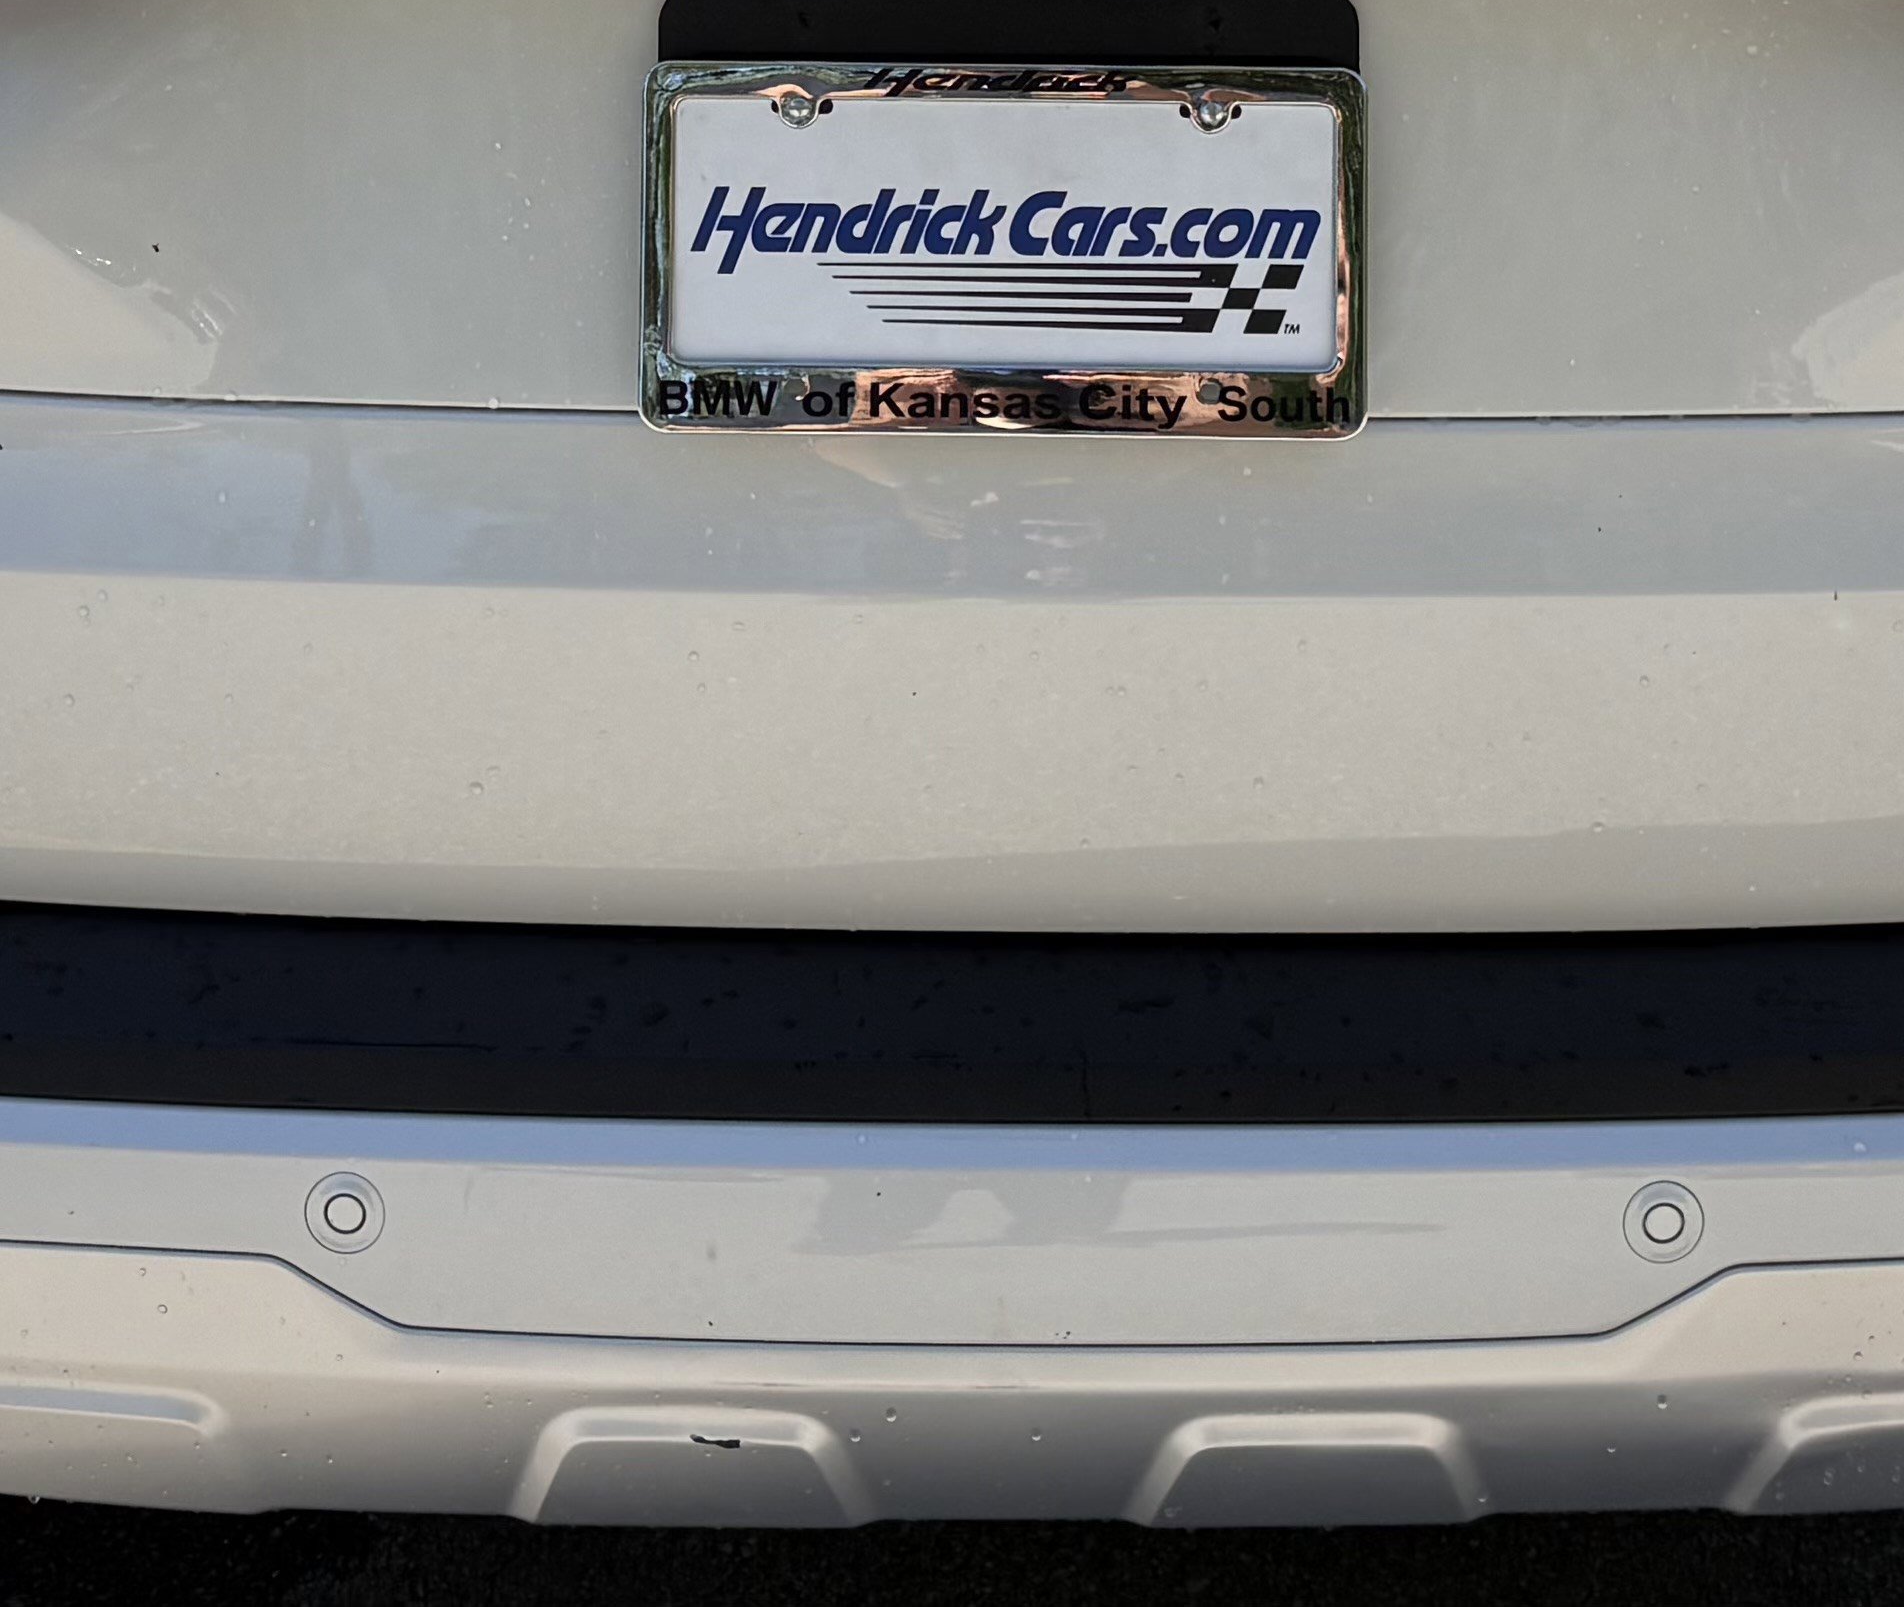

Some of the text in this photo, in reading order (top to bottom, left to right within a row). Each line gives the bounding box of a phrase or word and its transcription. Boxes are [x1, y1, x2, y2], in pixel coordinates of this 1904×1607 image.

[659, 379, 1352, 430] BMW of Kansas City South
